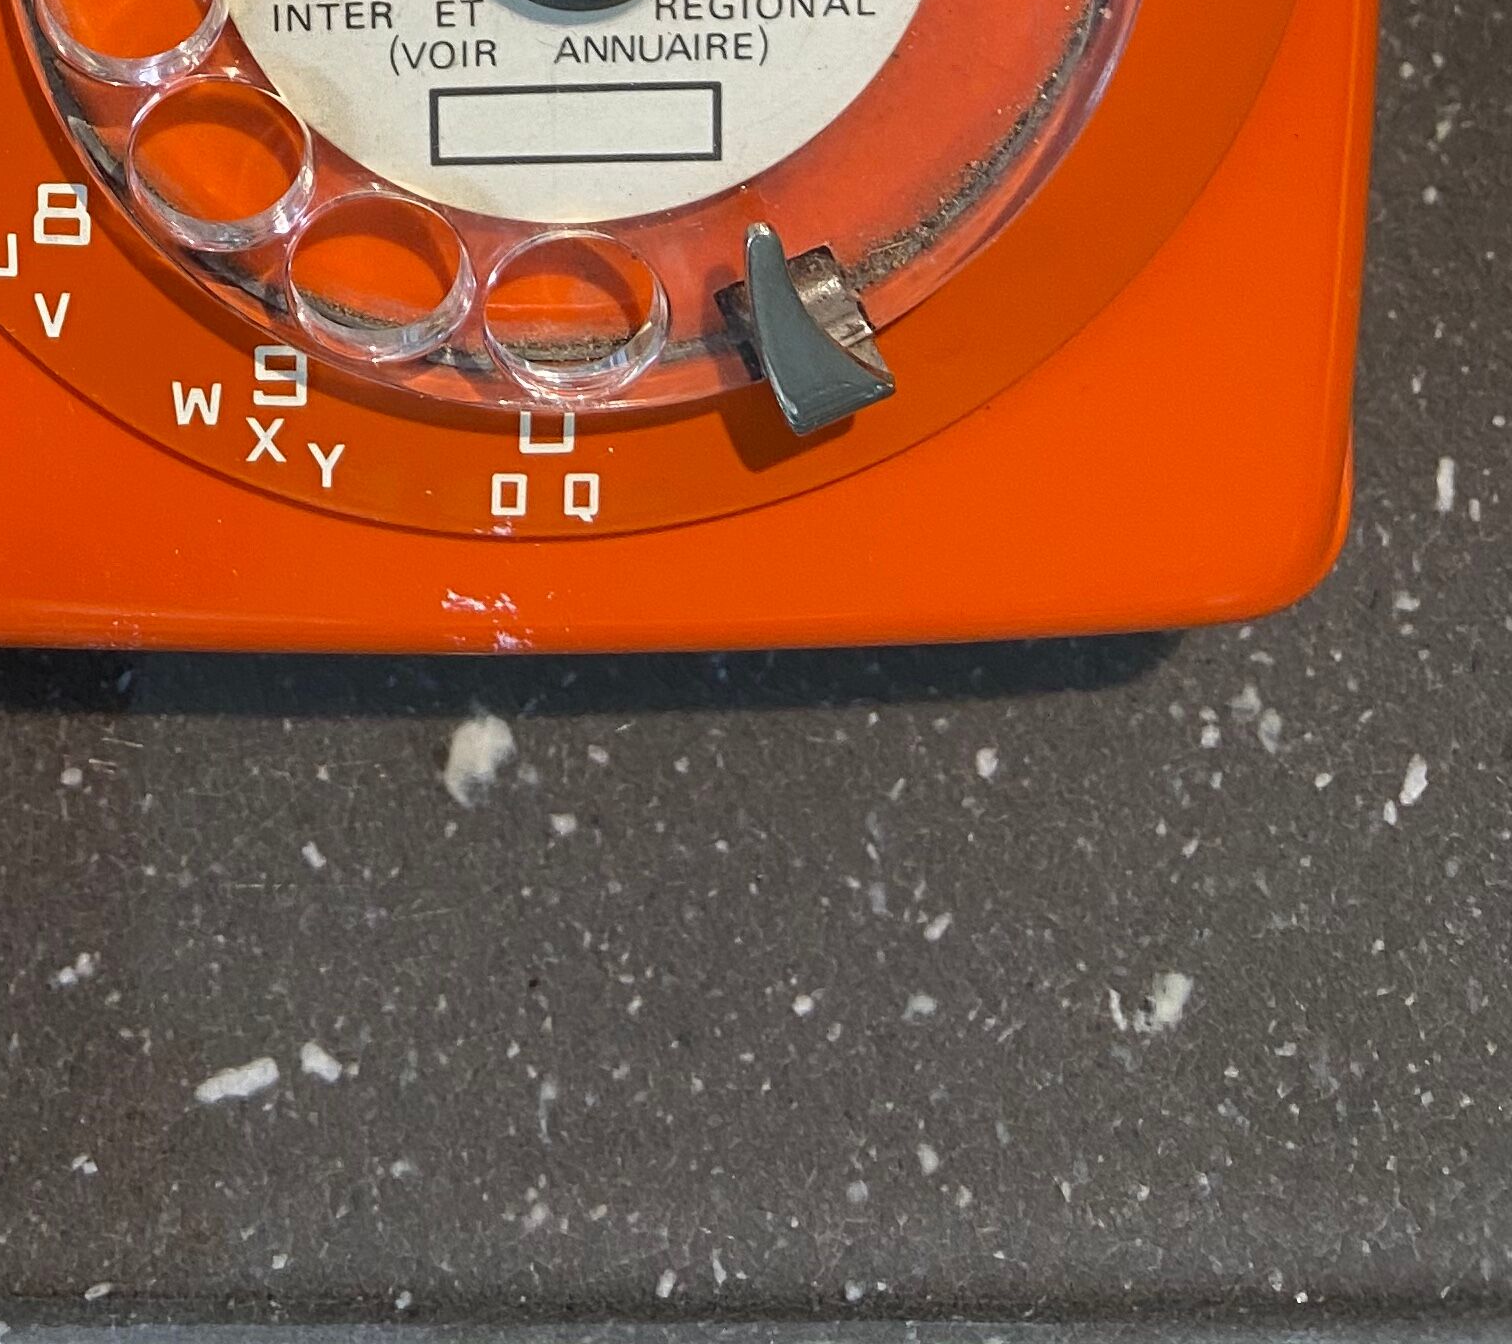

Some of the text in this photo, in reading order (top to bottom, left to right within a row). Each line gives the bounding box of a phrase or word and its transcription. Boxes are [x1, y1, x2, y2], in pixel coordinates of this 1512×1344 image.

[274, 1, 392, 32] INTER
[437, 0, 483, 27] ET
[390, 26, 767, 76] (VOIR ANNUAIRE)
[34, 183, 91, 245] 8
[254, 344, 308, 406] 9
